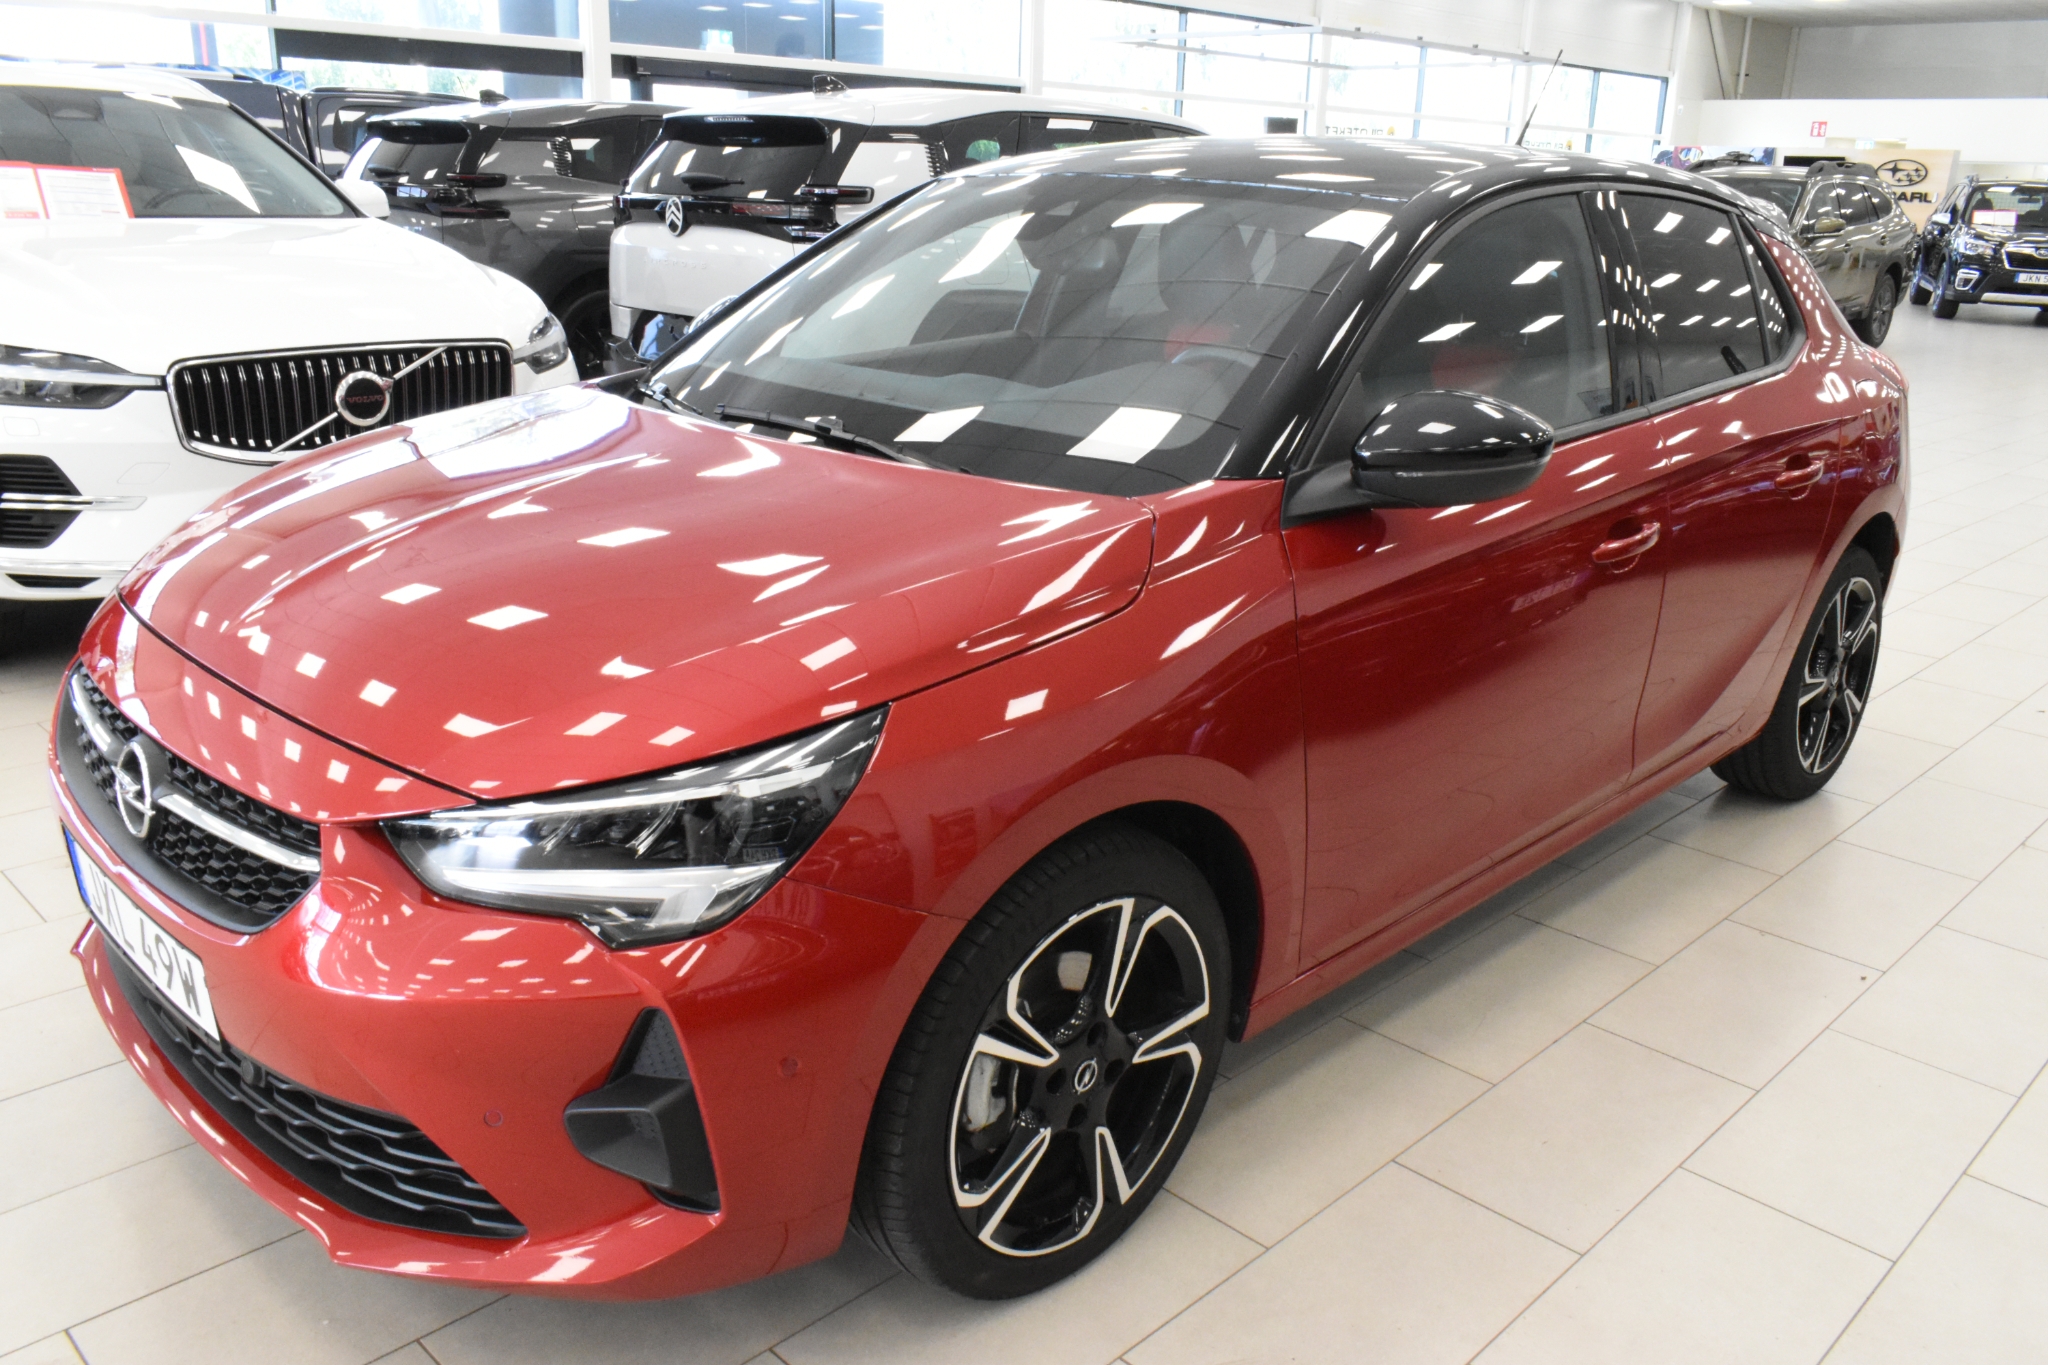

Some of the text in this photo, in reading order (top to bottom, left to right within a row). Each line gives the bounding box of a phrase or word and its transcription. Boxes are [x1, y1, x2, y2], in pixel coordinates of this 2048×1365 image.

[2022, 274, 2042, 283] JKN
[346, 395, 384, 403] VOLVO
[139, 917, 202, 1018] 49W
